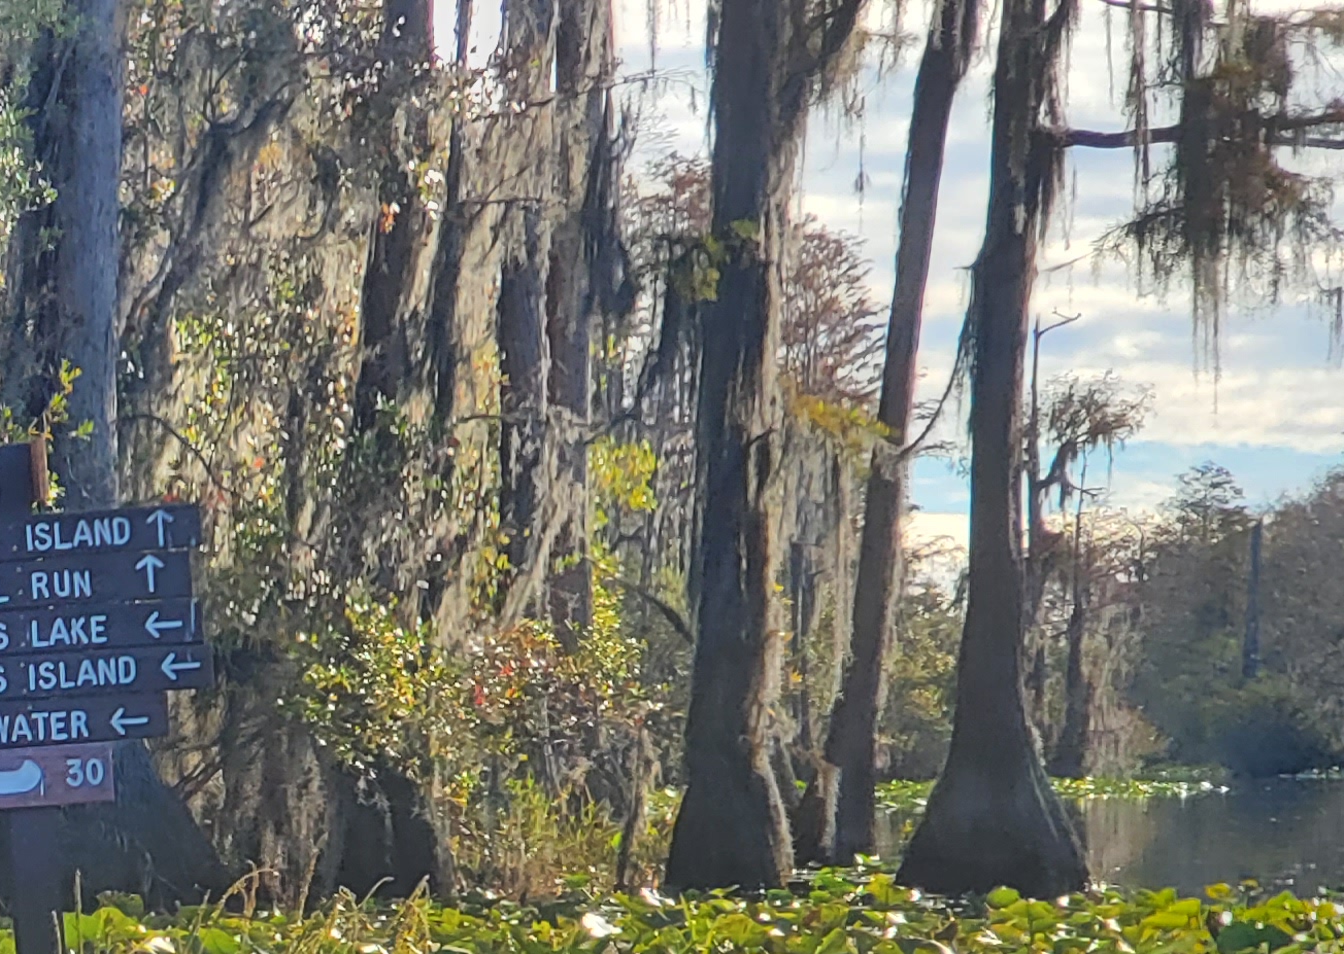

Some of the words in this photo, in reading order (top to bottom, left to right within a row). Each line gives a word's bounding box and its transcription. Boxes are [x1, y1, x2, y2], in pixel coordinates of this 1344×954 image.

[26, 516, 131, 551] ISLAND
[31, 570, 92, 600] RUN
[31, 615, 108, 648] LAKE
[28, 656, 137, 691] ISLAND
[65, 757, 104, 787] 30
